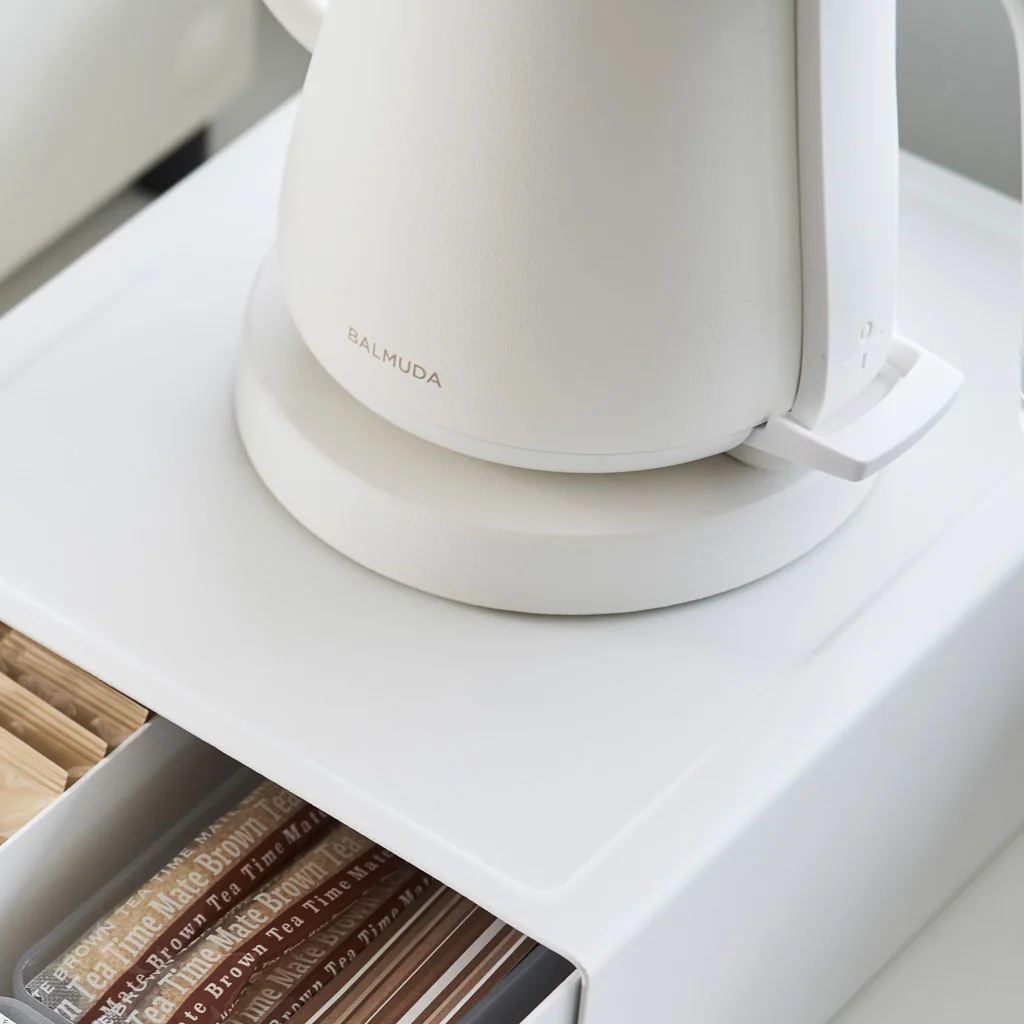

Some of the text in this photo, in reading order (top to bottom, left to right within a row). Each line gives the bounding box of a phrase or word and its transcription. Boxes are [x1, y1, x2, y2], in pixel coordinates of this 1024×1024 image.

[347, 326, 442, 388] BALMUDA
[53, 920, 117, 982] BROWN
[116, 888, 154, 917] TEA
[149, 847, 195, 882] TIME
[65, 961, 118, 1001] Tea
[101, 915, 164, 966] Time
[148, 870, 210, 921] Mate
[194, 817, 270, 877] Brown
[146, 913, 208, 970] Brown
[206, 881, 243, 912] Tea
[240, 841, 285, 881] Time
[158, 947, 222, 996] Time
[205, 906, 269, 952] Mate
[253, 861, 330, 915] Brown
[313, 836, 364, 866] Tea
[204, 942, 269, 1000] Brown
[264, 915, 305, 943] Tea
[302, 878, 352, 915] Time
[266, 946, 326, 989] Mate
[324, 948, 357, 976] Tea
[357, 907, 400, 946] Time
